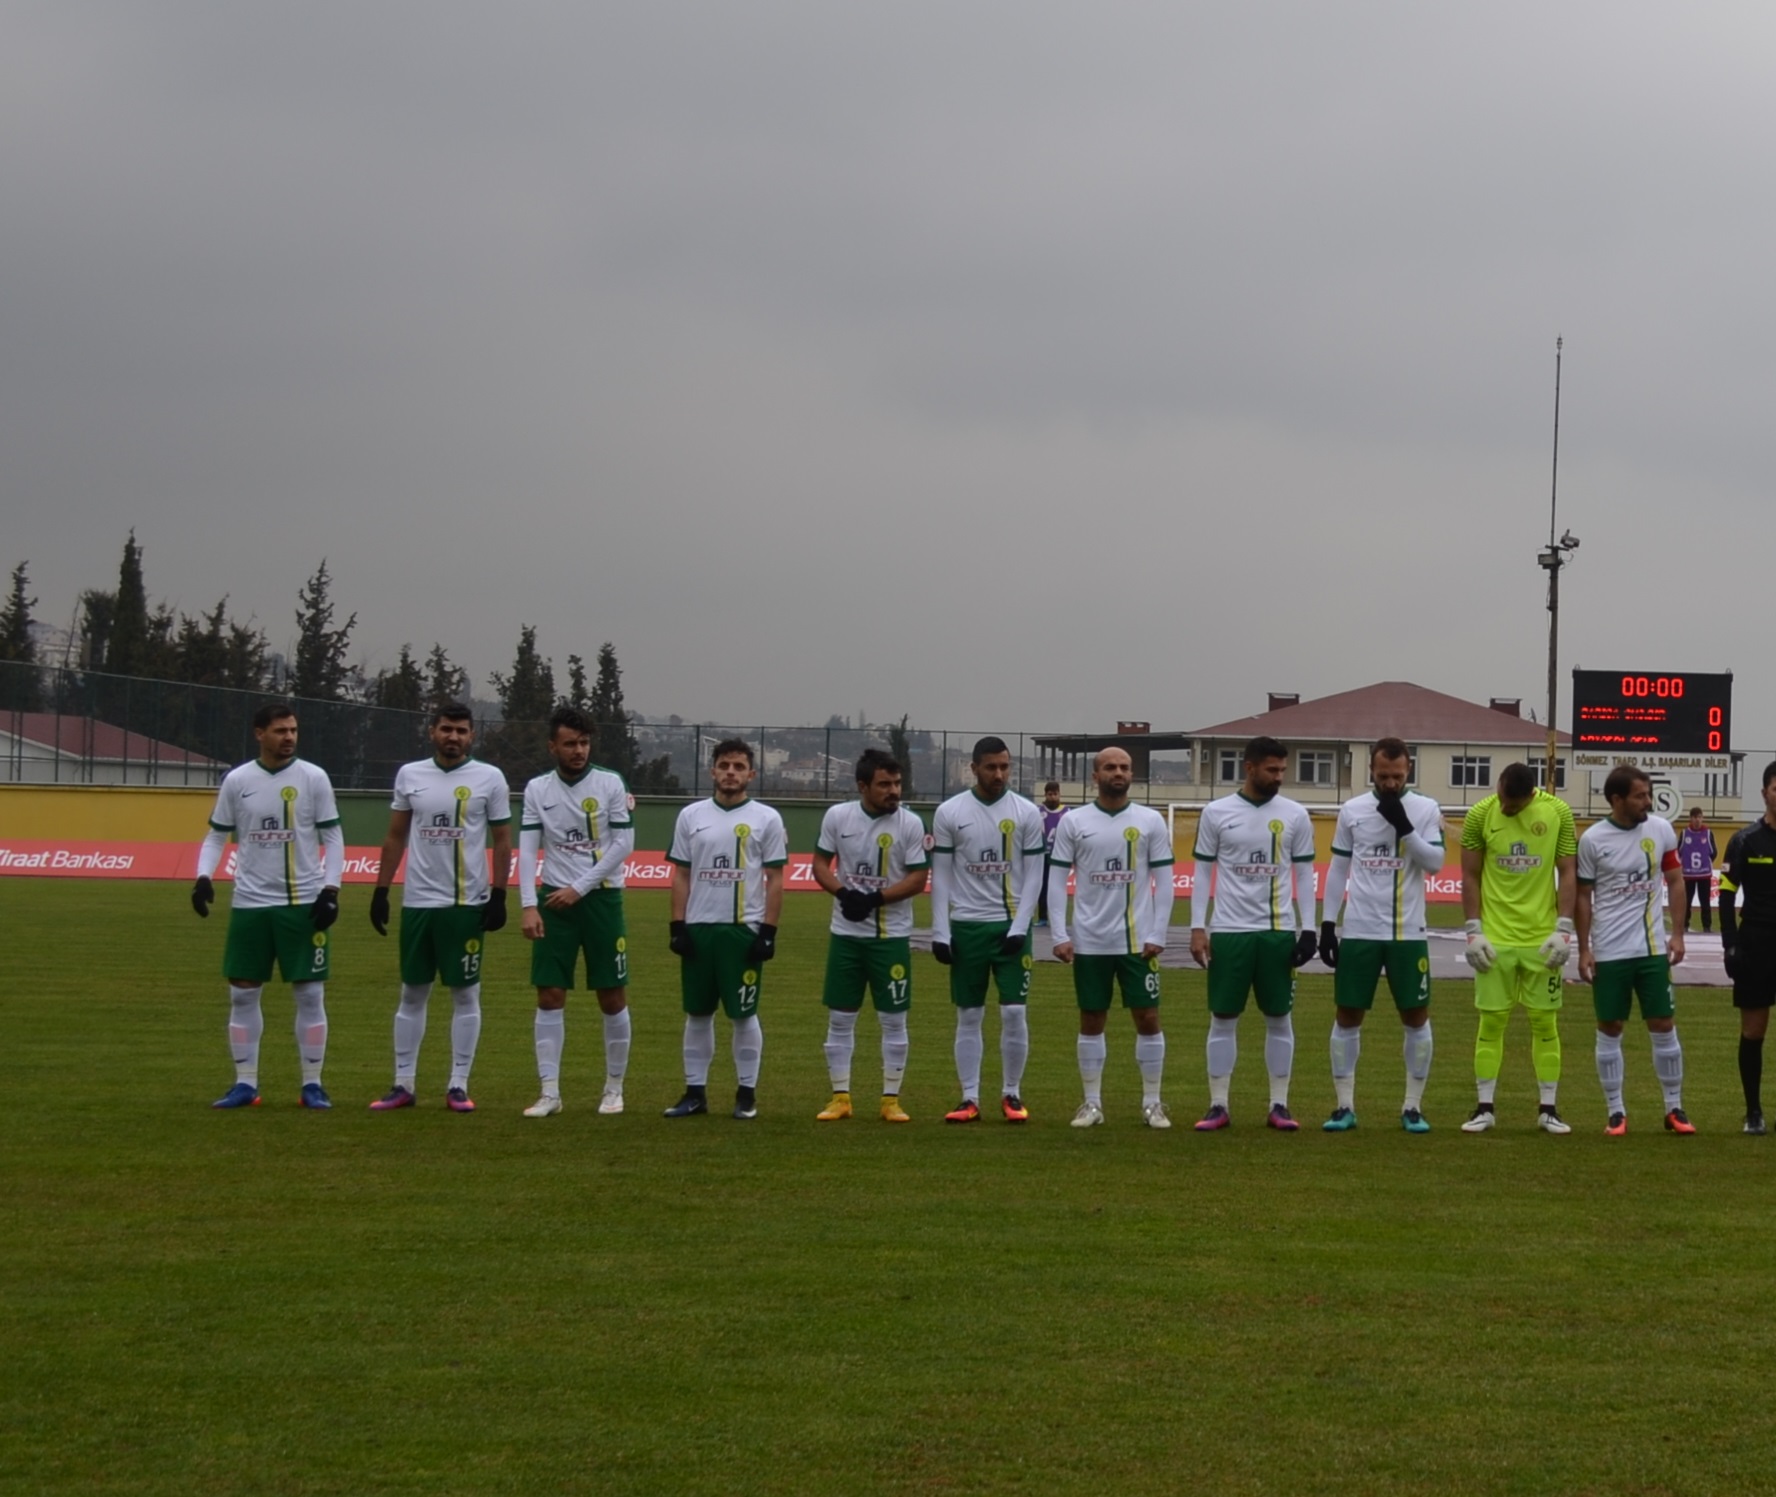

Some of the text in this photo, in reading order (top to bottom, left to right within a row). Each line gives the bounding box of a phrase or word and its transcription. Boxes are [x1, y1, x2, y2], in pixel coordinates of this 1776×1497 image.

[1622, 677, 1684, 697] 00:00
[1708, 707, 1721, 727] 0
[1708, 731, 1721, 750] 0
[1705, 756, 1728, 769] DİLER
[51, 850, 134, 869] Bankası
[1690, 852, 1702, 869] 6
[314, 948, 325, 966] 8
[461, 953, 480, 973] 15
[738, 985, 757, 1004] 12
[888, 979, 907, 998] 17
